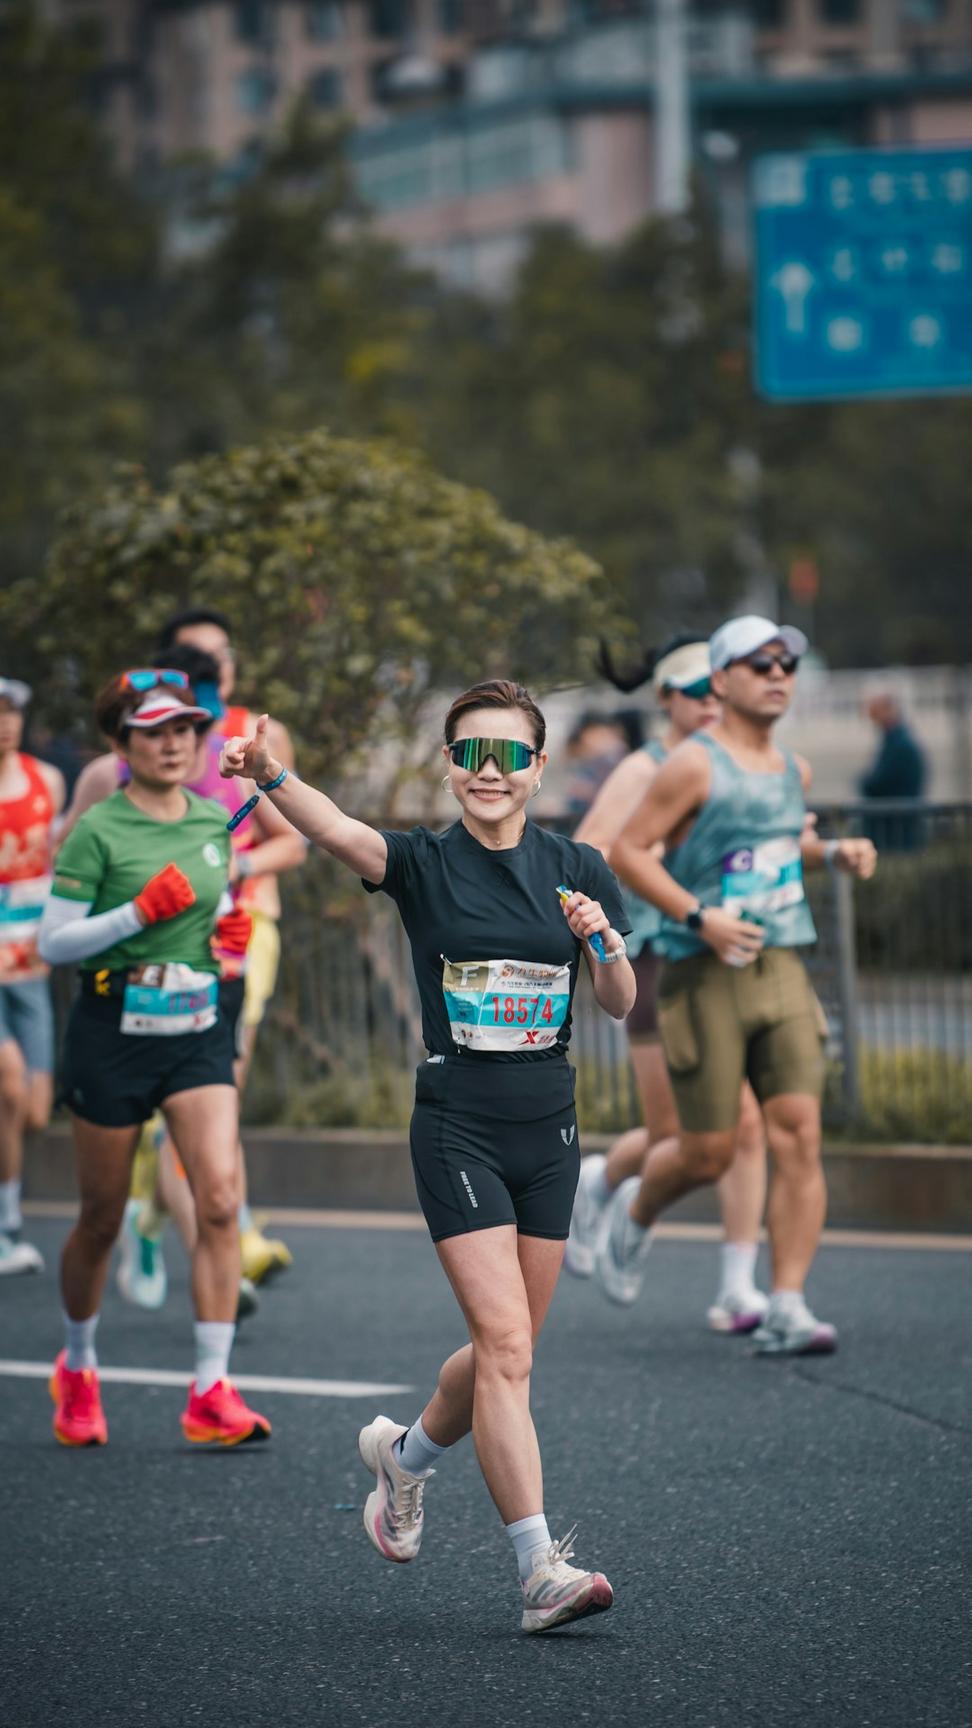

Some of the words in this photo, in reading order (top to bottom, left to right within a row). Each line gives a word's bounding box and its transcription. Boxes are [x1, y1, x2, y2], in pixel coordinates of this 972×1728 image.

[460, 966, 480, 986] F
[492, 996, 553, 1024] 18574
[469, 1193, 478, 1208] LEAD
